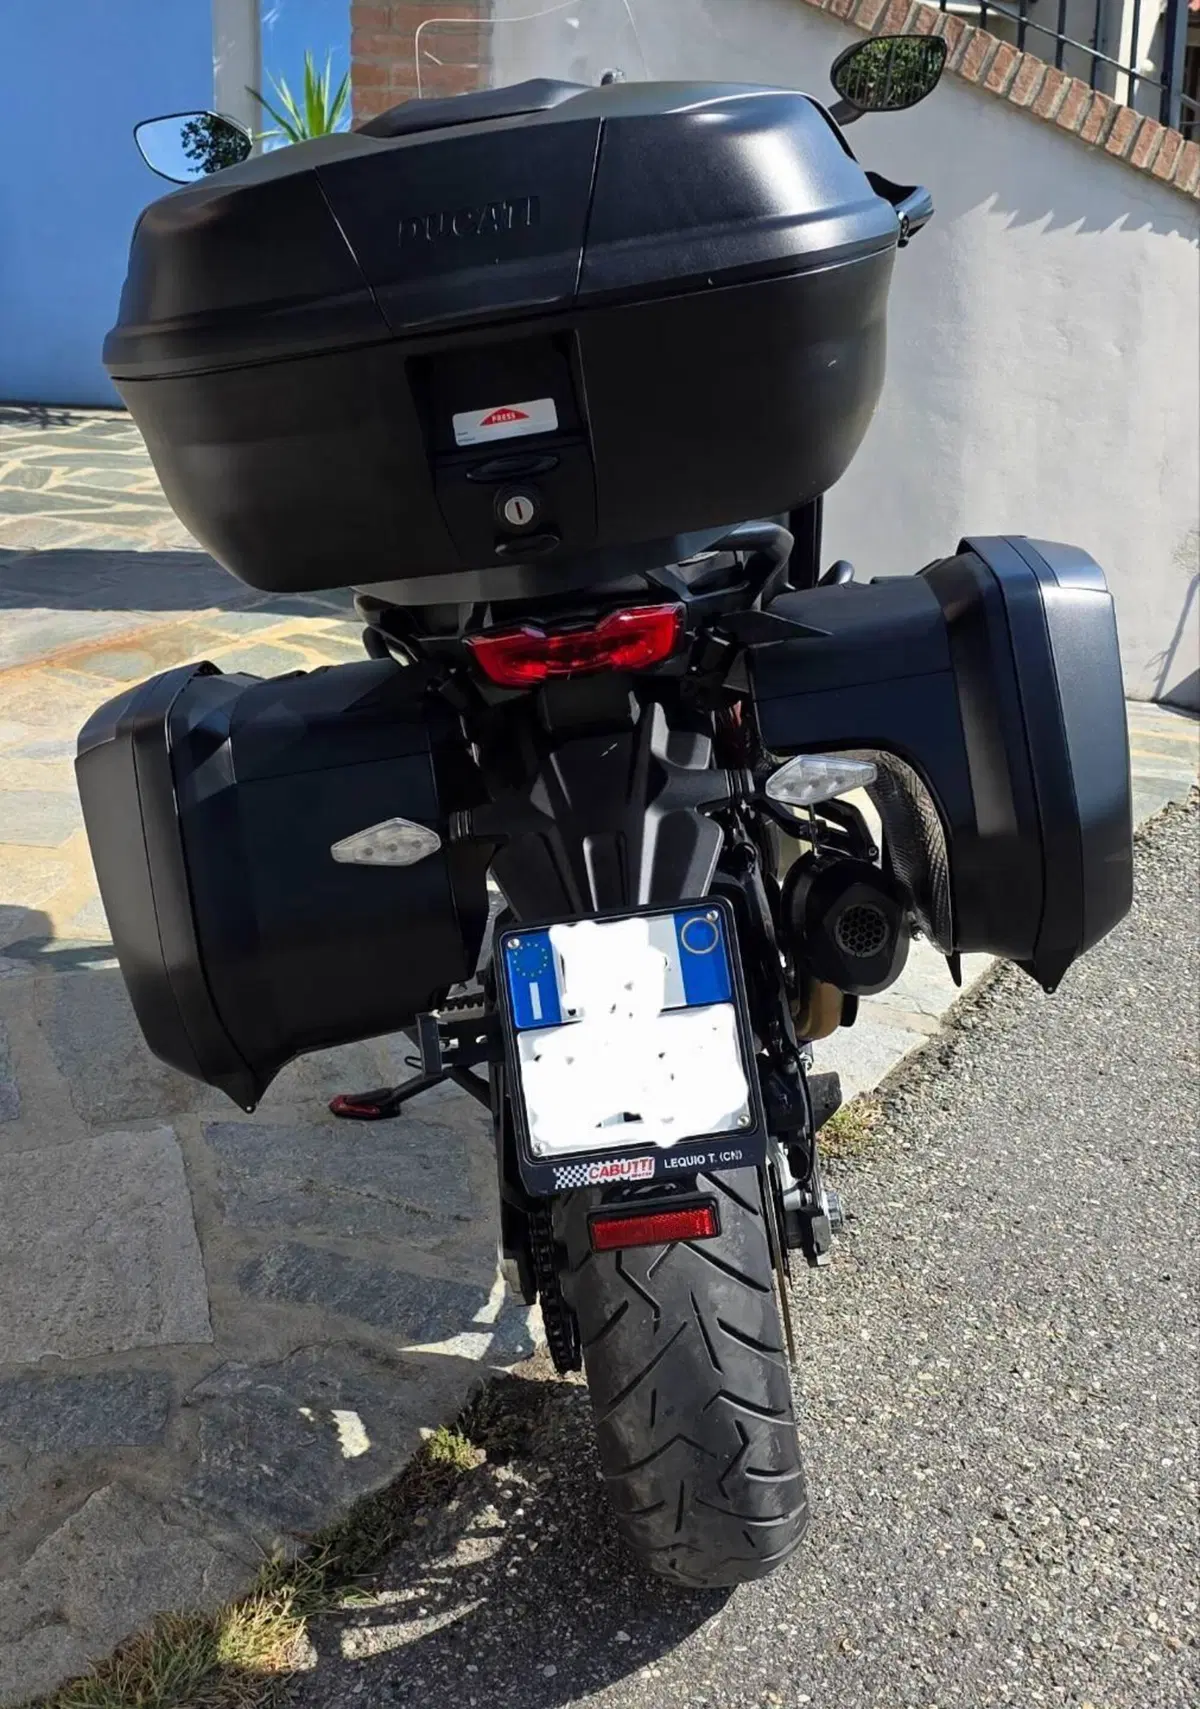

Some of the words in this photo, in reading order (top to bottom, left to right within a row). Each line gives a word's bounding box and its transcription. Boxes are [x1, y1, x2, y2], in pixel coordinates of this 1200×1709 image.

[398, 196, 540, 248] DUCATI
[492, 412, 516, 423] PRESS
[529, 982, 542, 1020] I
[589, 1158, 653, 1179] CABUTTI
[663, 1155, 706, 1169] LEQUIO
[707, 1153, 717, 1163] T.
[719, 1149, 743, 1162] (CN)
